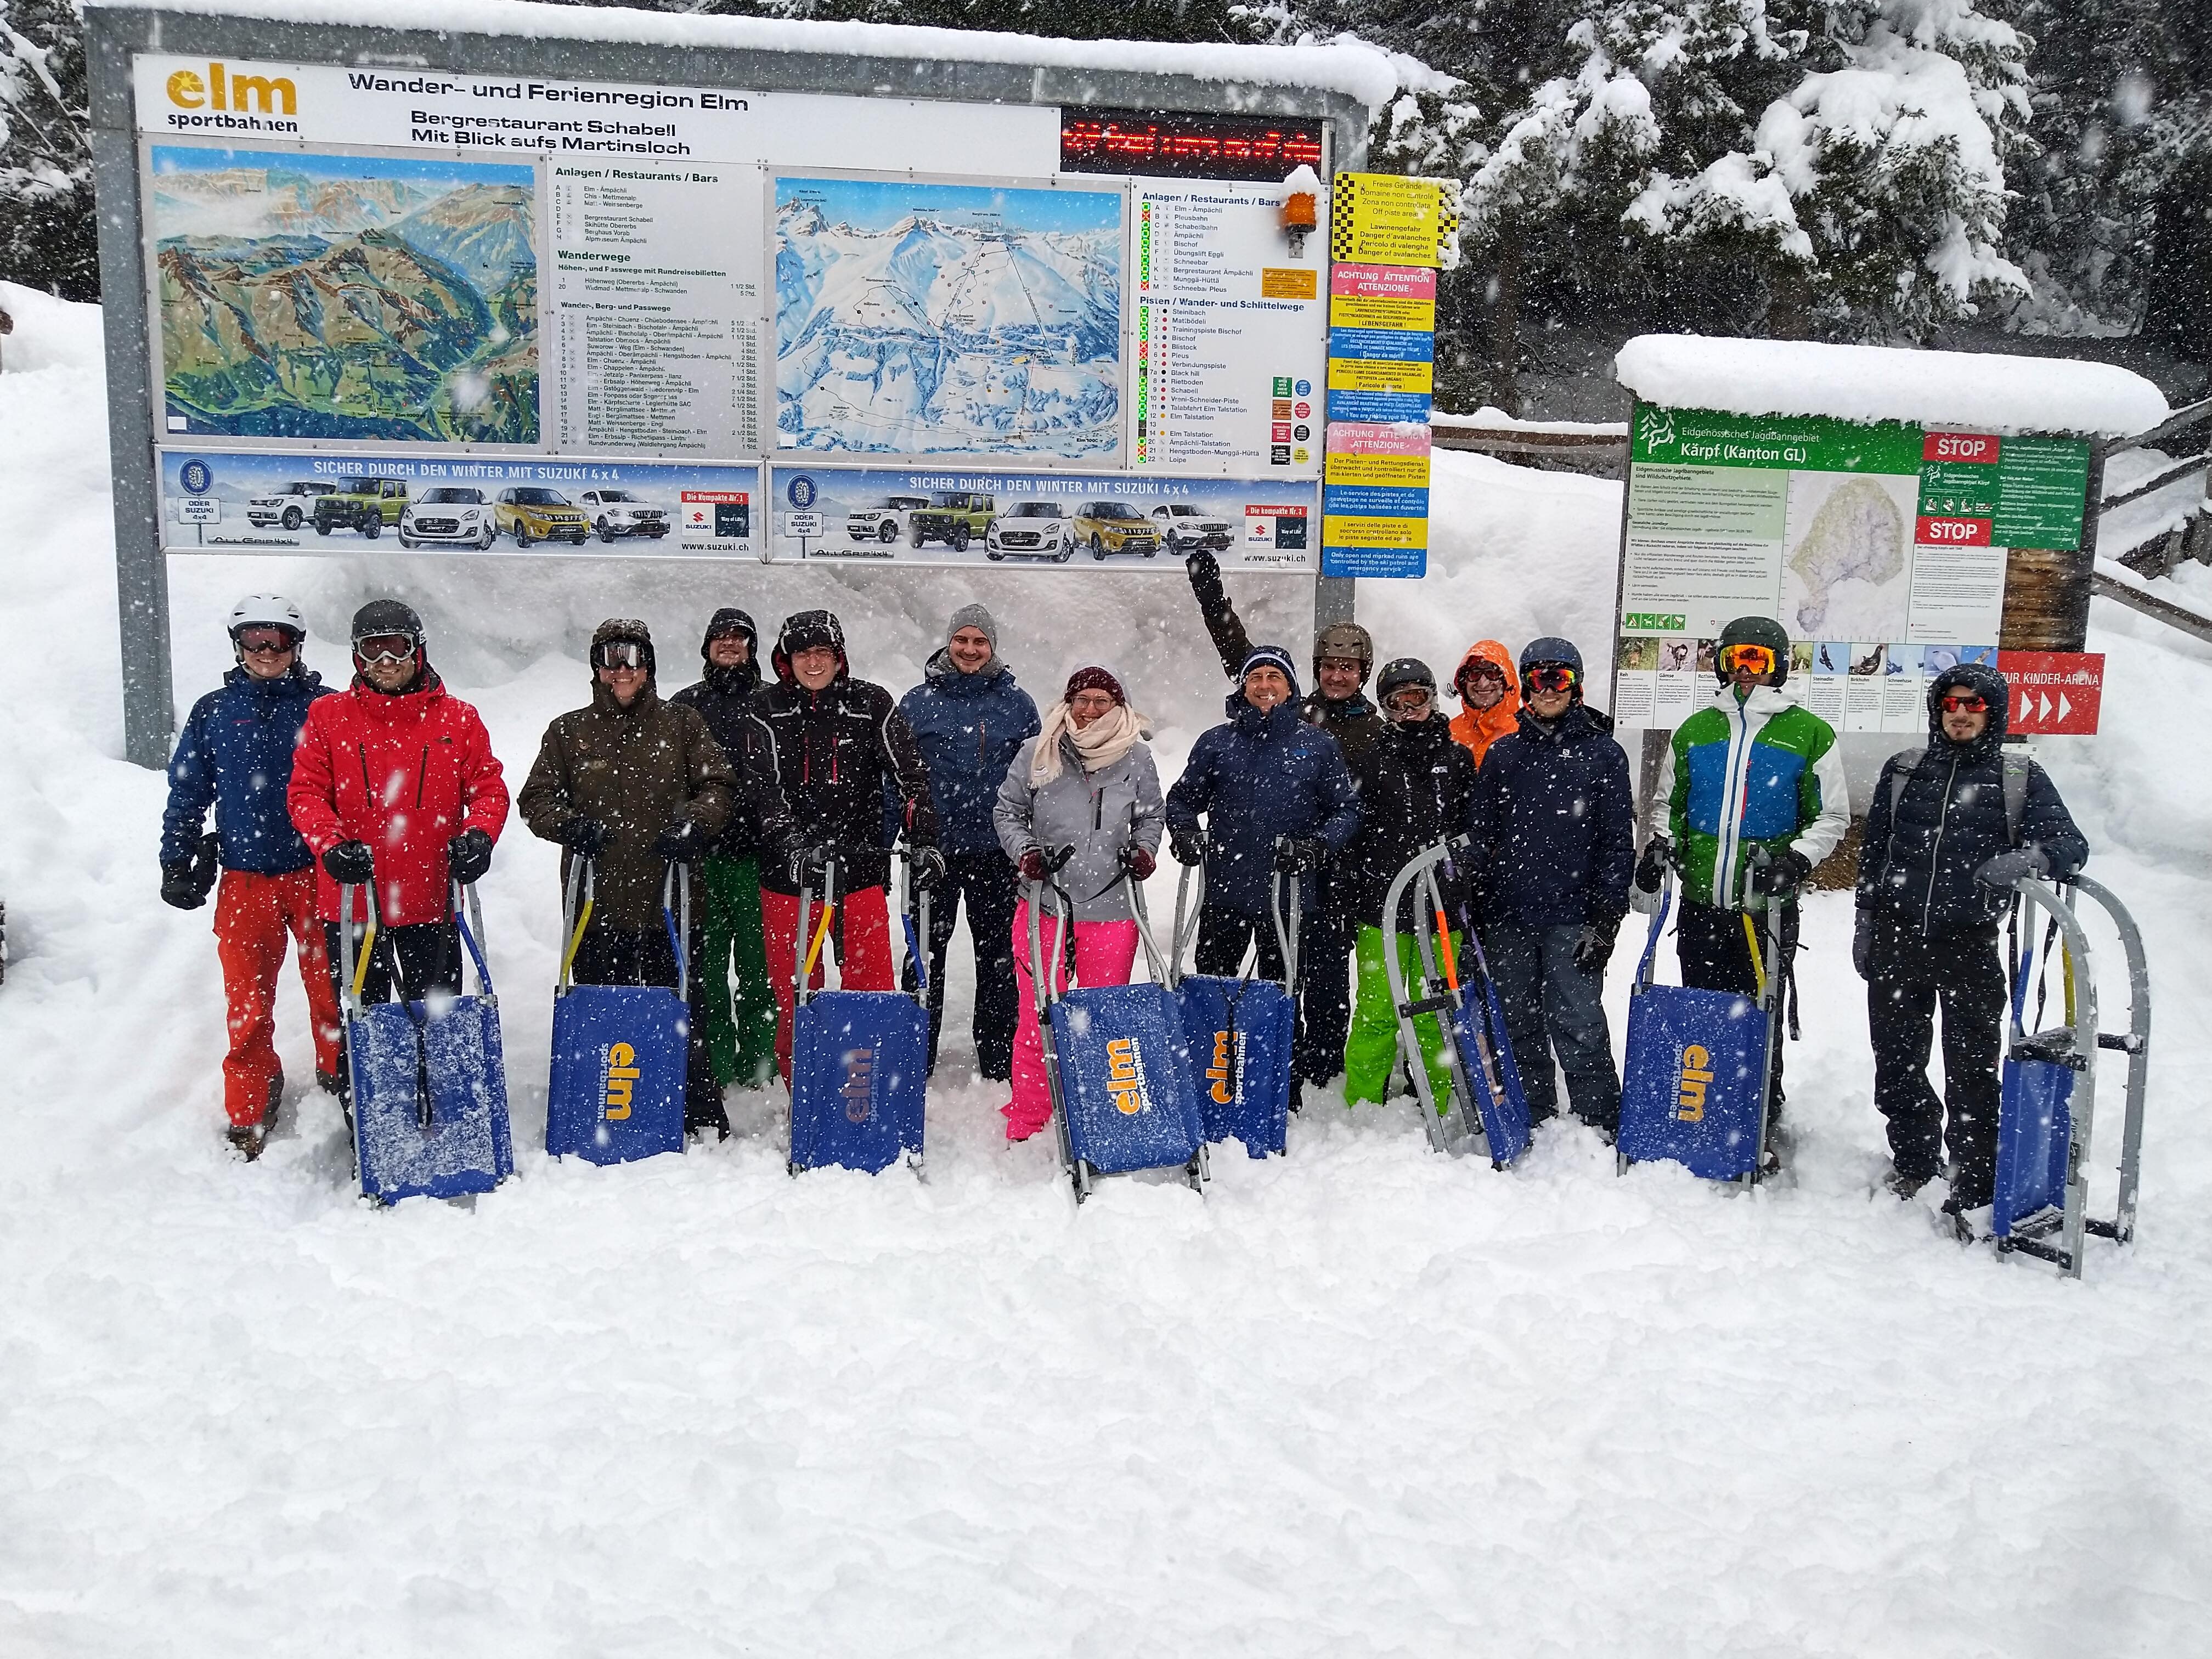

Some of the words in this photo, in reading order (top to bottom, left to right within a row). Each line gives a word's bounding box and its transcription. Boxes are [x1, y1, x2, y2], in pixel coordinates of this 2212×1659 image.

[166, 63, 297, 115] elm
[348, 74, 466, 95] Wander-
[472, 83, 521, 99] und
[528, 84, 693, 110] Ferienregion
[701, 94, 748, 111] Elm
[167, 112, 298, 133] sportbahnen
[411, 111, 583, 133] Bergrestaurant
[588, 121, 675, 137] Schabell
[411, 129, 449, 144] Mit
[454, 131, 505, 146] Blick
[511, 135, 557, 149] aufs
[562, 138, 690, 156] Martinsloch
[556, 168, 601, 178] Anlagen
[605, 169, 610, 178] /
[613, 170, 681, 181] Restaurants
[684, 172, 689, 182] /
[692, 173, 718, 183] Bars
[1142, 193, 1181, 202] Anlagen
[1191, 195, 1249, 205] Restaurants
[1370, 223, 1421, 232] Lawinengefahr
[558, 250, 630, 262] Wanderwege
[1358, 248, 1383, 256] Danger
[1338, 271, 1378, 280] ACHTUNG
[1384, 273, 1429, 283] ATTENTION
[1357, 283, 1409, 292] ATTENZIONE
[1140, 296, 1170, 305] Pisten
[1179, 298, 1217, 307] Wander-
[1240, 301, 1304, 312] Schlittelwege
[1172, 361, 1226, 369] Verbindungspiste
[1751, 430, 1820, 443] Jagdbanngebiet
[1681, 443, 1720, 458] Kärpf
[1724, 444, 1778, 461] (Kanton
[1784, 446, 1806, 464] GL)
[1938, 439, 1985, 456] STOP
[314, 462, 363, 474] SICHER
[369, 464, 415, 476] DURCH
[421, 465, 447, 476] DEN
[453, 466, 504, 478] WINTER
[509, 467, 532, 478] MIT
[538, 467, 587, 479] SUZUKI
[591, 469, 599, 479] 4
[612, 470, 619, 481] 4
[910, 477, 955, 489] SICHER
[960, 478, 1001, 490] DURCH
[1007, 480, 1031, 491] DEN
[1036, 481, 1082, 493] WINTER
[1088, 482, 1110, 493] MIT
[1115, 483, 1159, 494] SUZUKI
[1163, 484, 1170, 494] 4
[1182, 484, 1189, 495] 4
[1930, 522, 1977, 539] STOP
[274, 537, 292, 545] 4x4
[681, 543, 749, 551] www.suzuki.ch
[2000, 673, 2019, 683] ZUR
[2023, 673, 2098, 685] KINDER-ARENA
[1107, 1038, 1140, 1115] elm
[1131, 1037, 1150, 1112] sportbahnen
[1205, 1031, 1238, 1104] elm
[1234, 1032, 1247, 1104] sportbahnen
[597, 1043, 609, 1119] sportbahnen
[606, 1042, 640, 1120] elm
[841, 1049, 873, 1122] elm
[1678, 1045, 1714, 1122] elm
